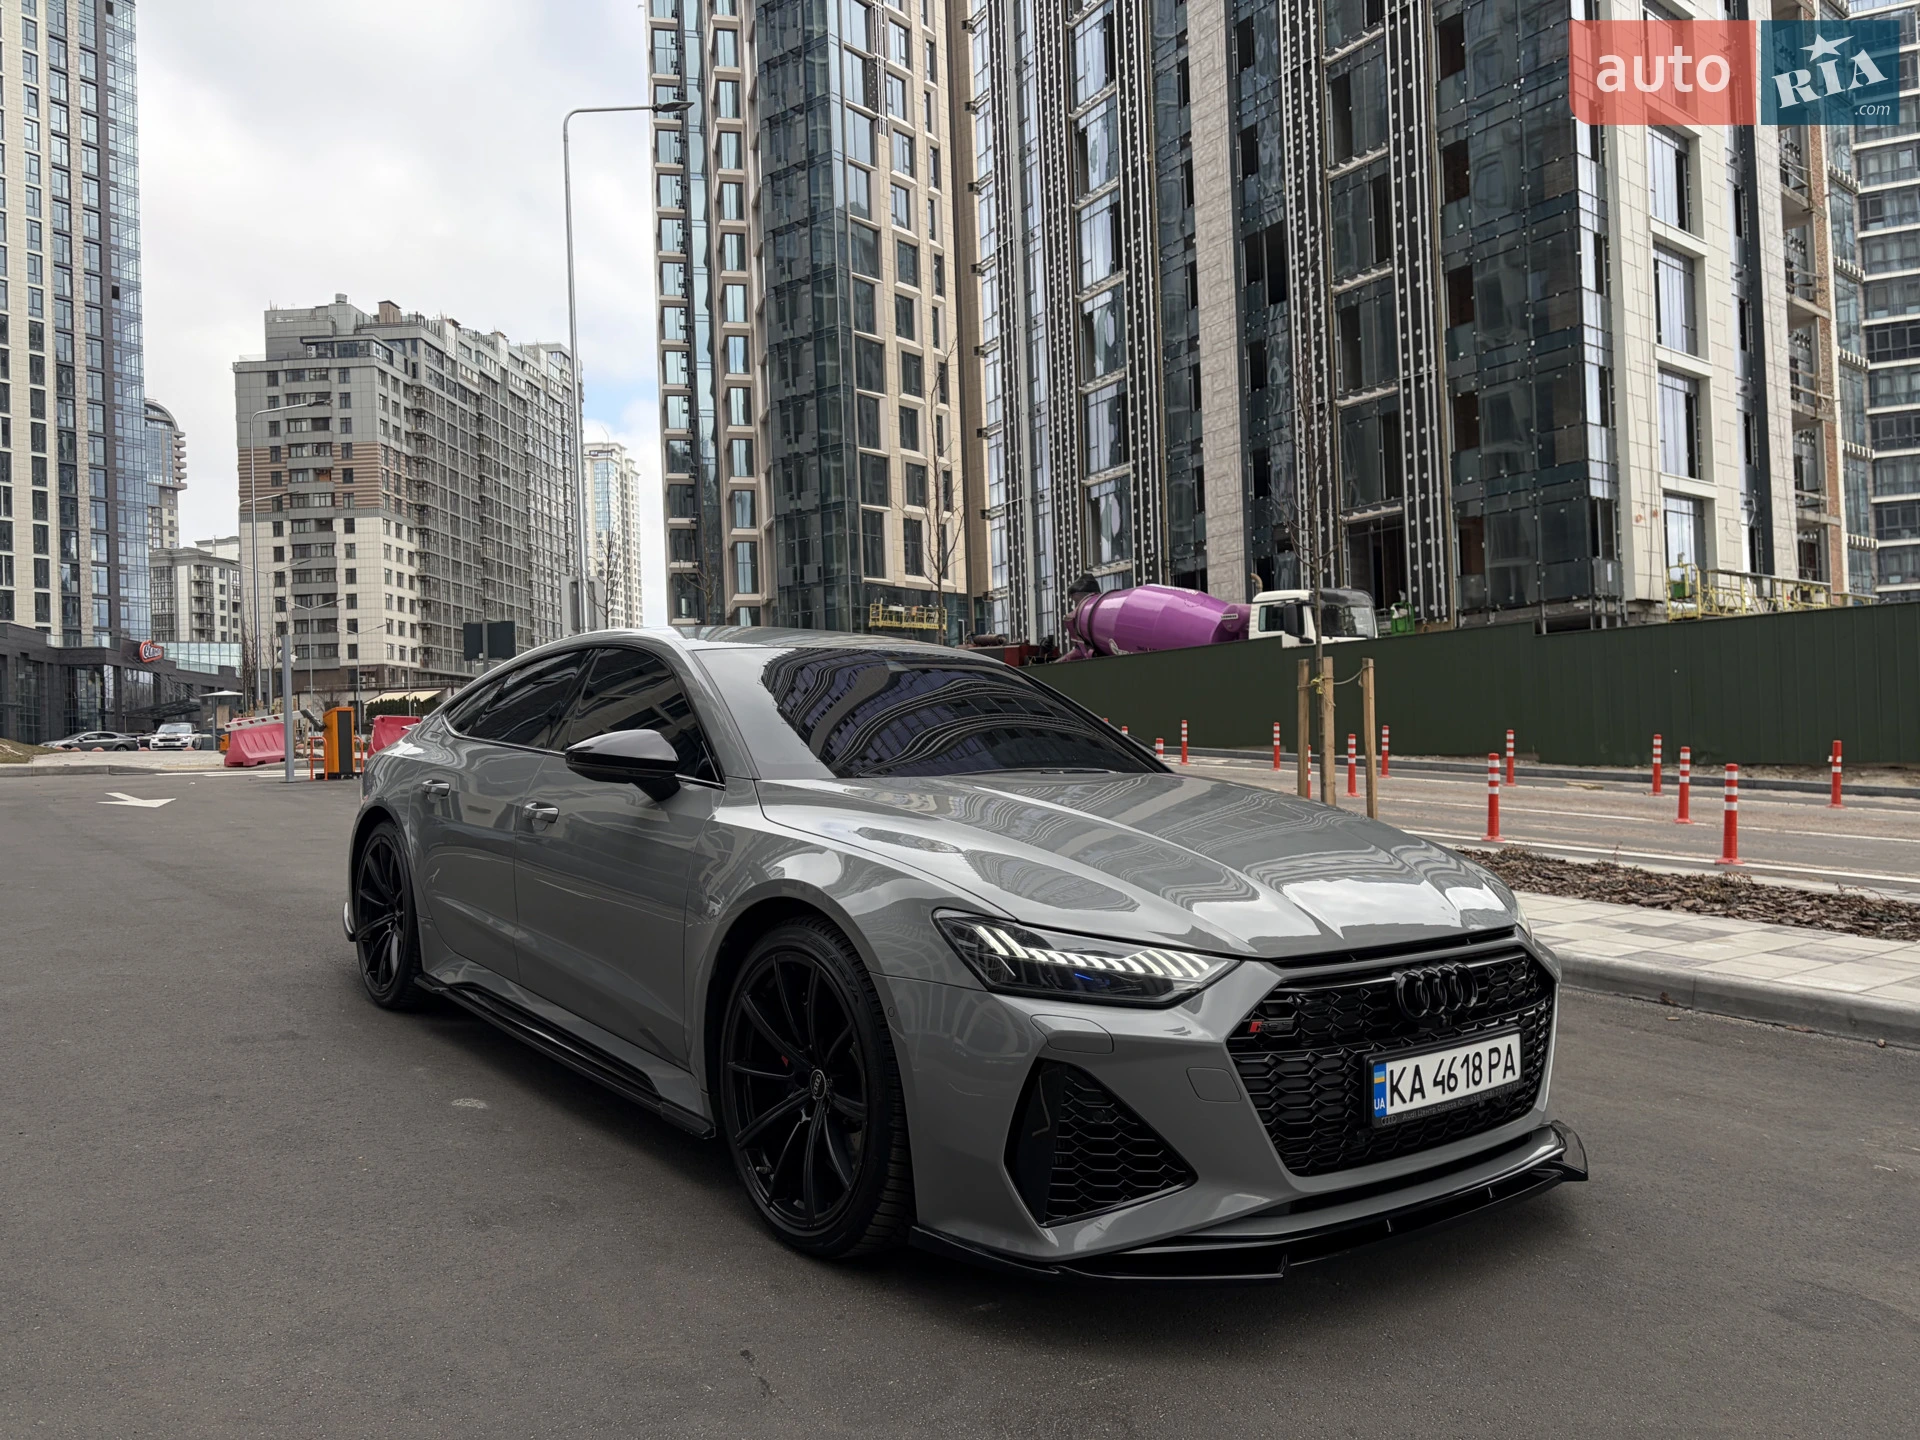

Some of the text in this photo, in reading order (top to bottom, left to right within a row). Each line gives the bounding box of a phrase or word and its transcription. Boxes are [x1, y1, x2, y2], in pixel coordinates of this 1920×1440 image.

[1389, 1043, 1516, 1107] KA 4618 PA
[1374, 1098, 1386, 1110] UA
